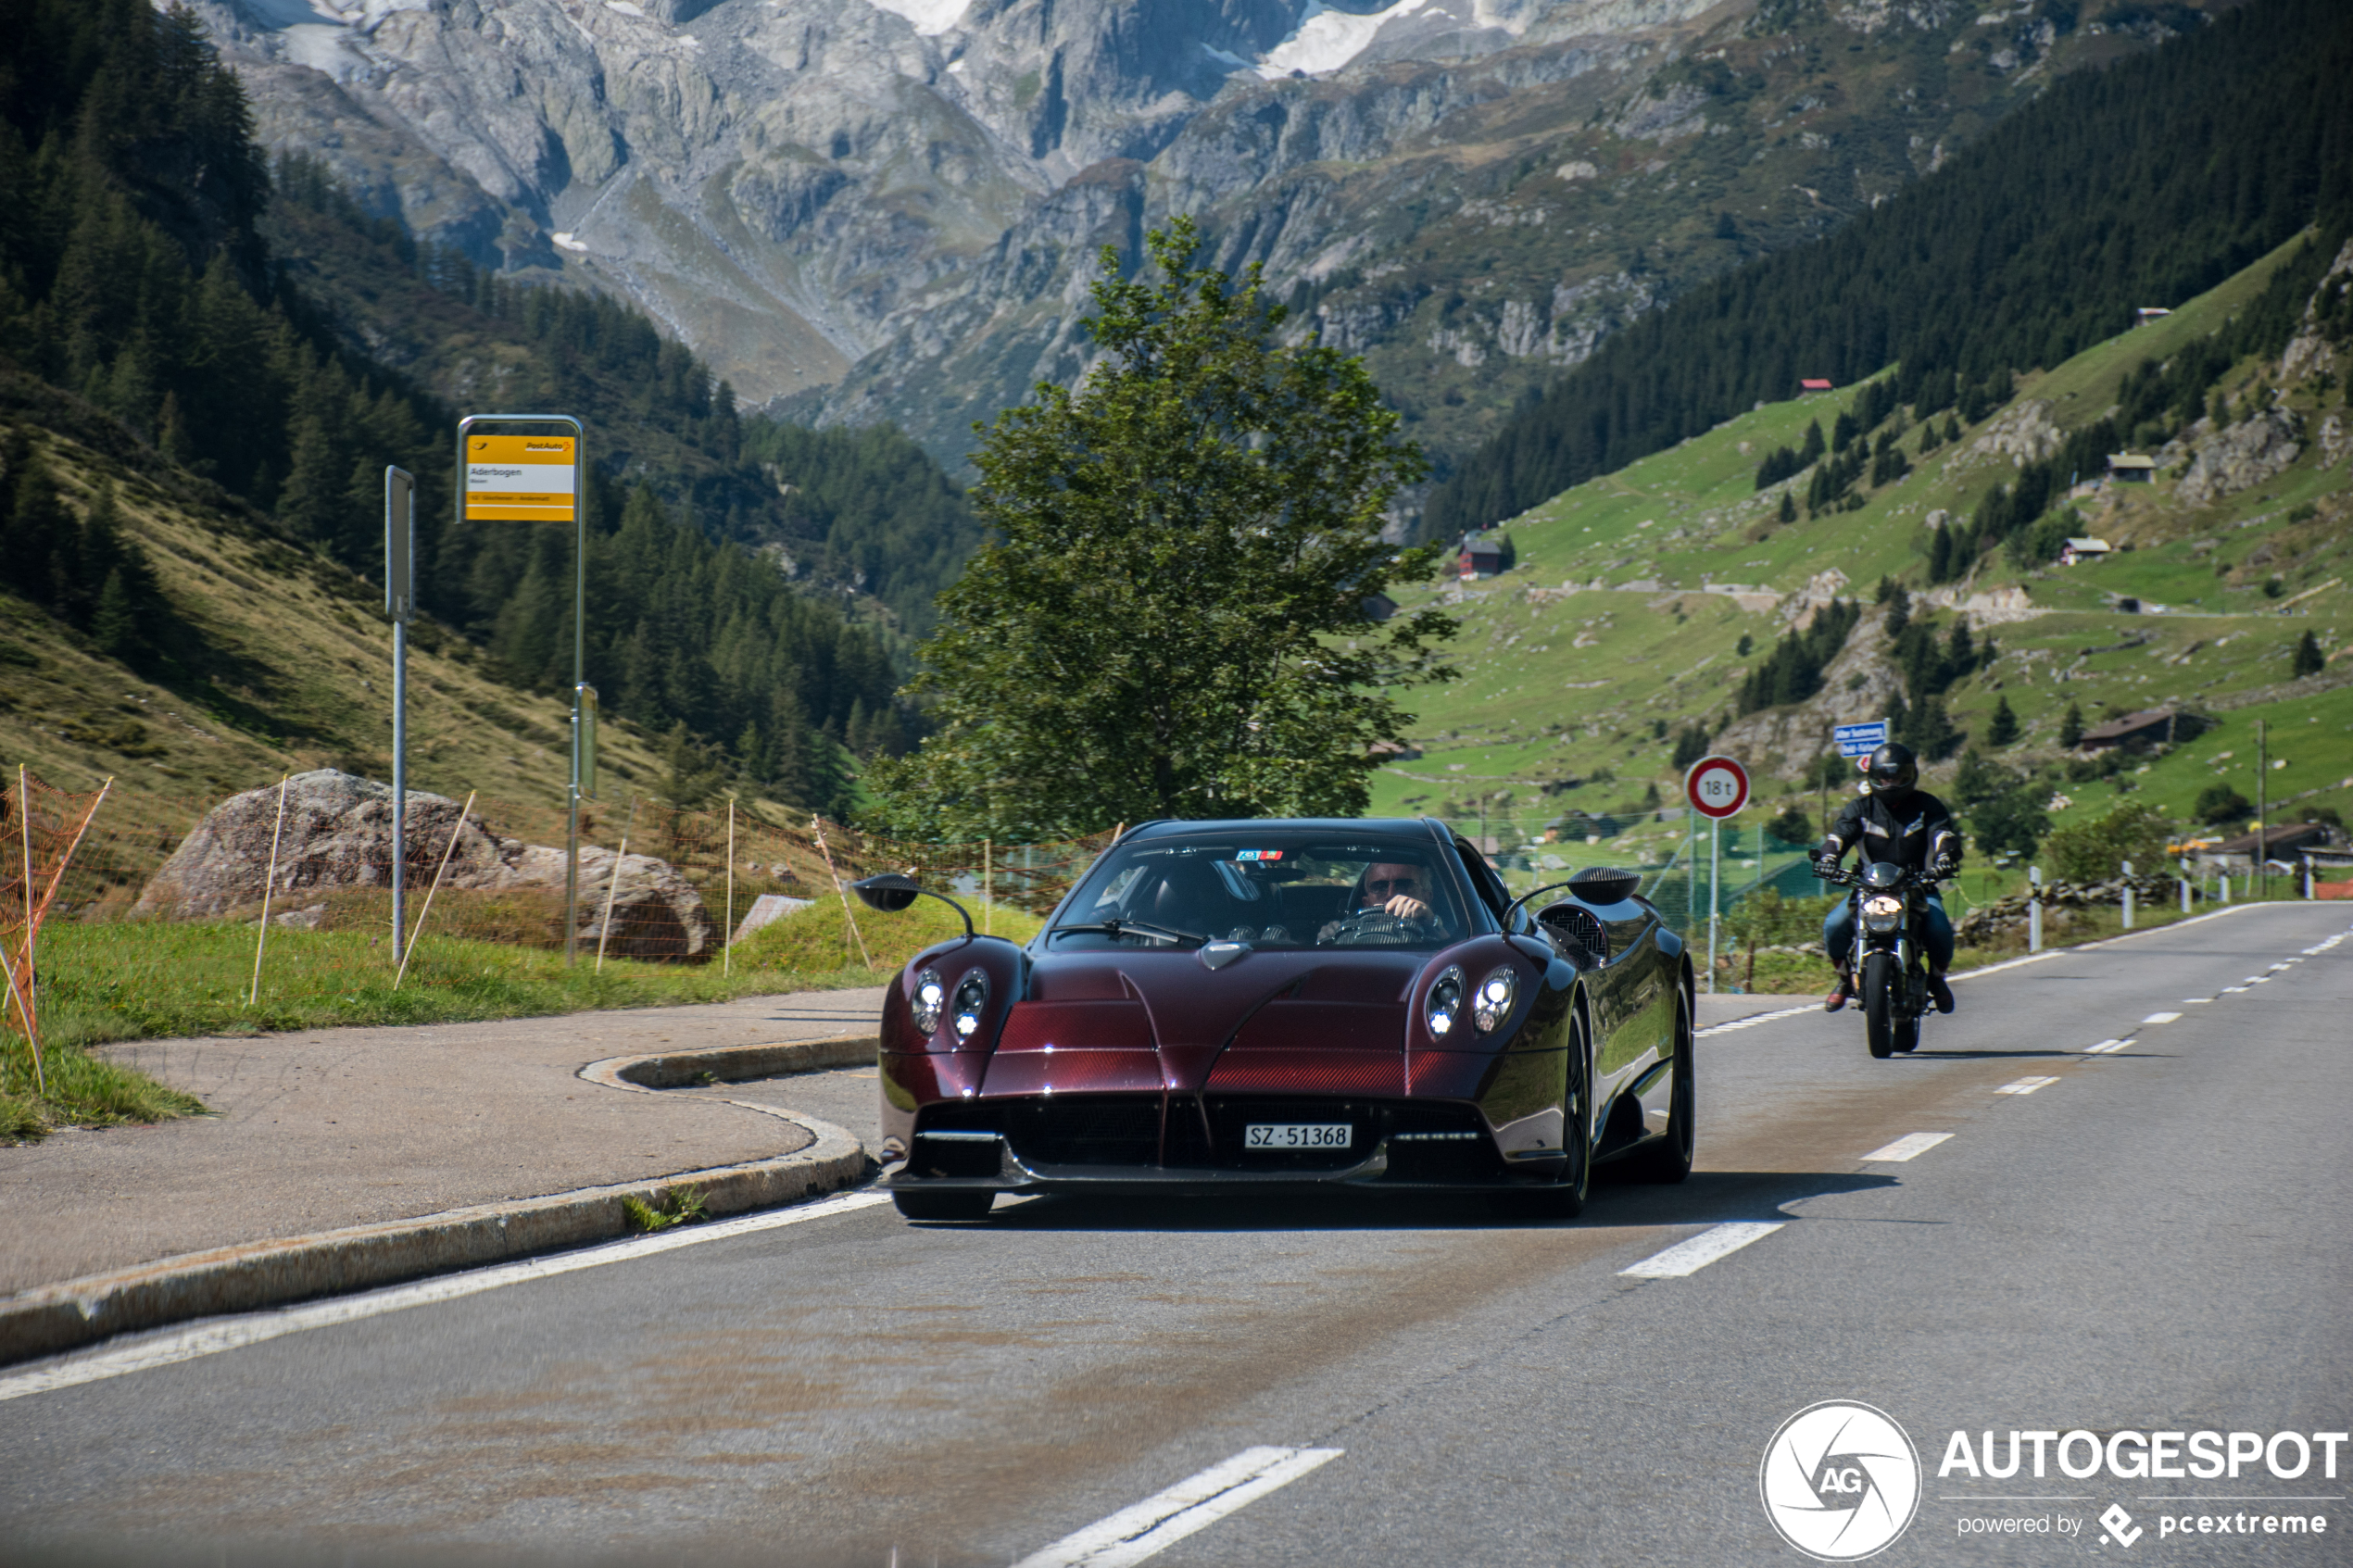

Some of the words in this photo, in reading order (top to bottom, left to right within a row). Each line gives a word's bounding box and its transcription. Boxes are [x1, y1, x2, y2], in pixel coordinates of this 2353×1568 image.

[526, 442, 563, 450] PostAuto
[469, 467, 522, 478] Aderbogen
[1705, 781, 1721, 796] 18
[1724, 782, 1731, 796] t
